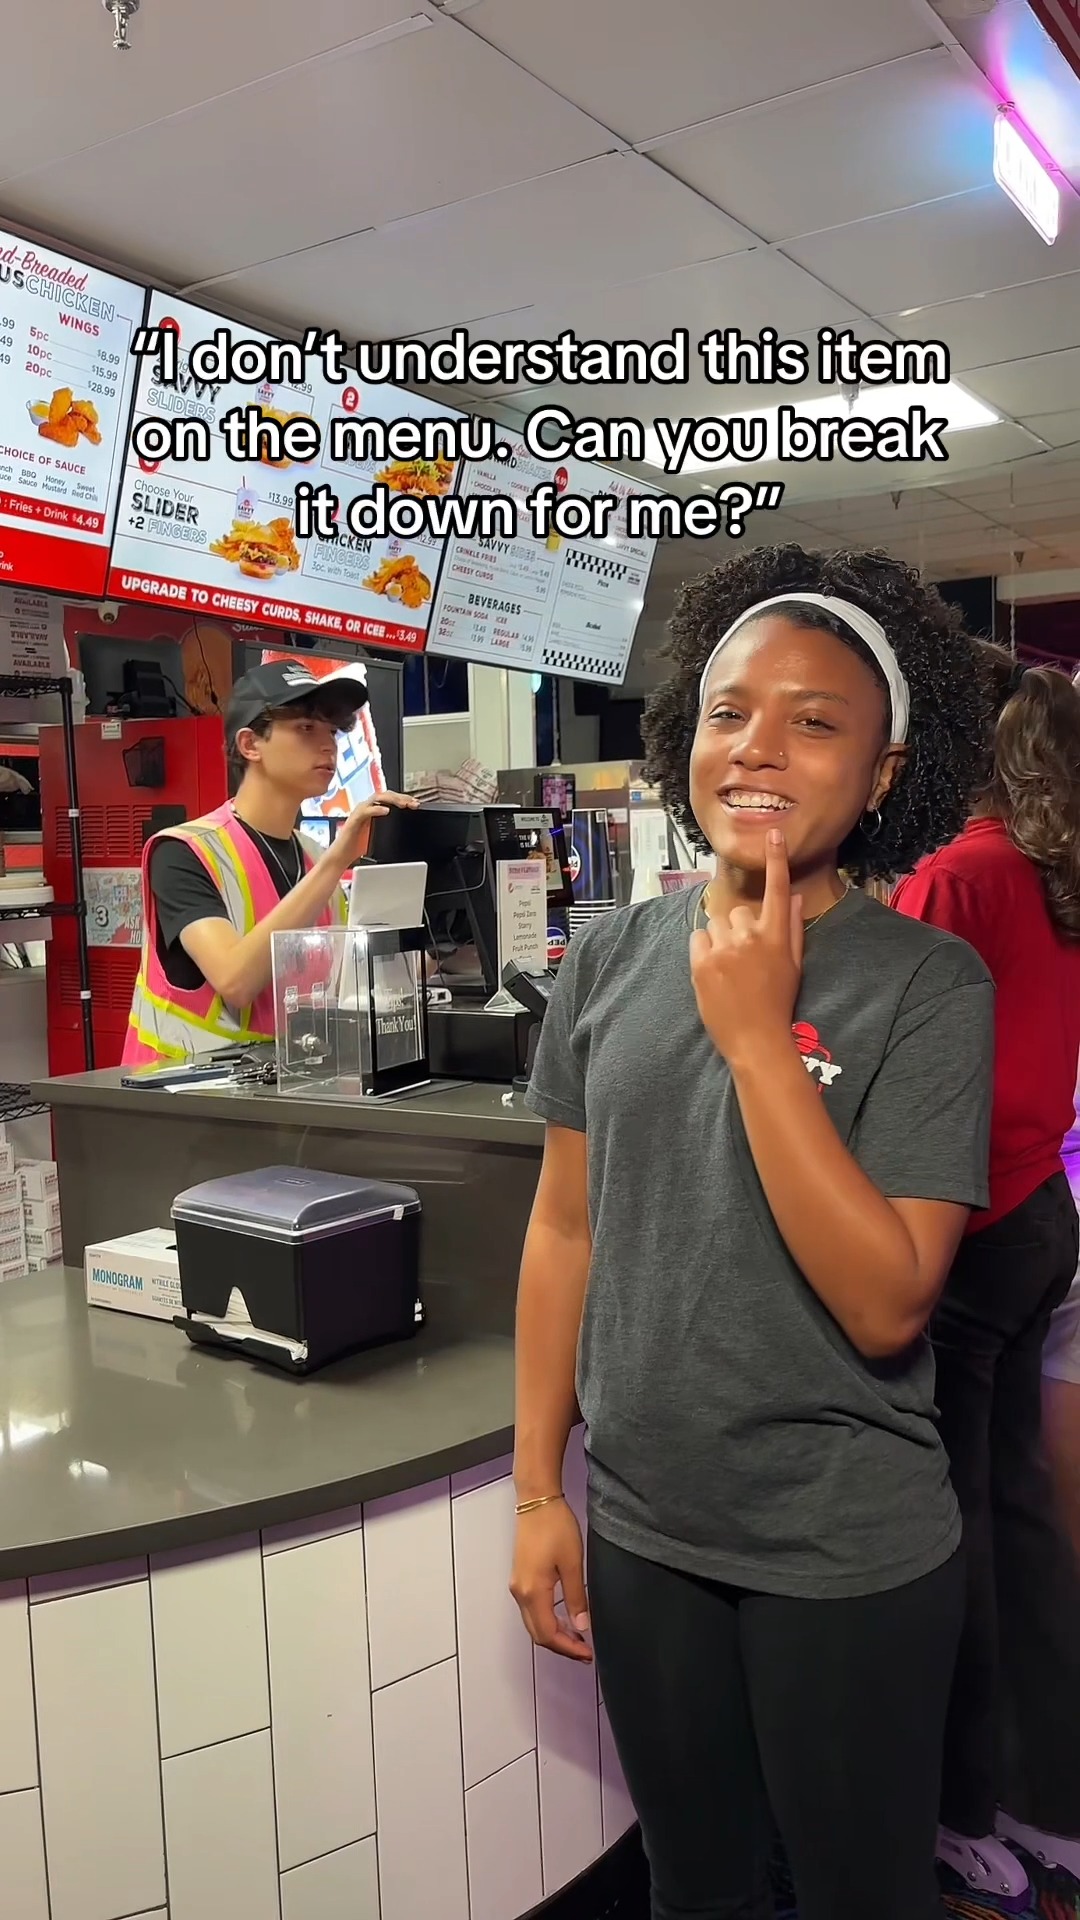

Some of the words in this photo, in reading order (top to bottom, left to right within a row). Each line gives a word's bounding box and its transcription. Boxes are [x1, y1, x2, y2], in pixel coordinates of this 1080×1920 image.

[58, 311, 100, 337] WINGS
[29, 325, 50, 341] 5pc
[97, 348, 121, 366] $8.99
[26, 343, 53, 360] 10pc
[91, 364, 119, 382] $15.99
[25, 360, 53, 378] 20pc
[87, 380, 117, 398] $28.99
[146, 388, 217, 425] SLIDERS
[345, 390, 356, 408] 2
[21, 469, 38, 480] BBQ
[38, 455, 53, 467] OF
[54, 459, 87, 476] SAUCE
[18, 477, 38, 488] Sauce
[41, 481, 68, 495] Mustard
[45, 474, 66, 487] Honey
[76, 482, 96, 493] Sweet
[71, 489, 84, 499] Red
[134, 479, 171, 498] Choose
[173, 488, 195, 504] Your
[268, 491, 294, 507] $13.99
[9, 499, 34, 514] Fries
[43, 506, 69, 522] Drink
[72, 513, 100, 529] $4.49
[130, 491, 200, 527] SLIDER
[128, 515, 145, 530] +2
[147, 517, 208, 545] FINGERS
[313, 542, 371, 570] FINGERS
[455, 546, 480, 560] CRINKLE
[481, 552, 497, 564] FRIES
[327, 565, 342, 576] with
[451, 563, 474, 576] CHEESY
[121, 578, 187, 601] UPGRADE
[191, 588, 209, 604] TO
[212, 592, 260, 614] CHEESY
[261, 604, 303, 624] CURDS,
[304, 611, 344, 631] SHAKE,
[345, 619, 361, 633] OR
[396, 629, 418, 643] $3.49
[443, 604, 472, 617] FOUNTAIN
[473, 610, 489, 621] SODA
[467, 592, 522, 616] BEVERAGES
[490, 636, 511, 649] LARGE
[492, 627, 520, 640] REGULAR
[518, 899, 532, 911] Pepsi
[512, 911, 526, 923] Pepsi
[512, 932, 538, 942] Lemonade
[512, 944, 524, 954] Fruit
[523, 943, 539, 952] Punch
[375, 1015, 399, 1035] Thank
[398, 1013, 417, 1033] You!
[91, 1267, 144, 1291] MONOGRAM
